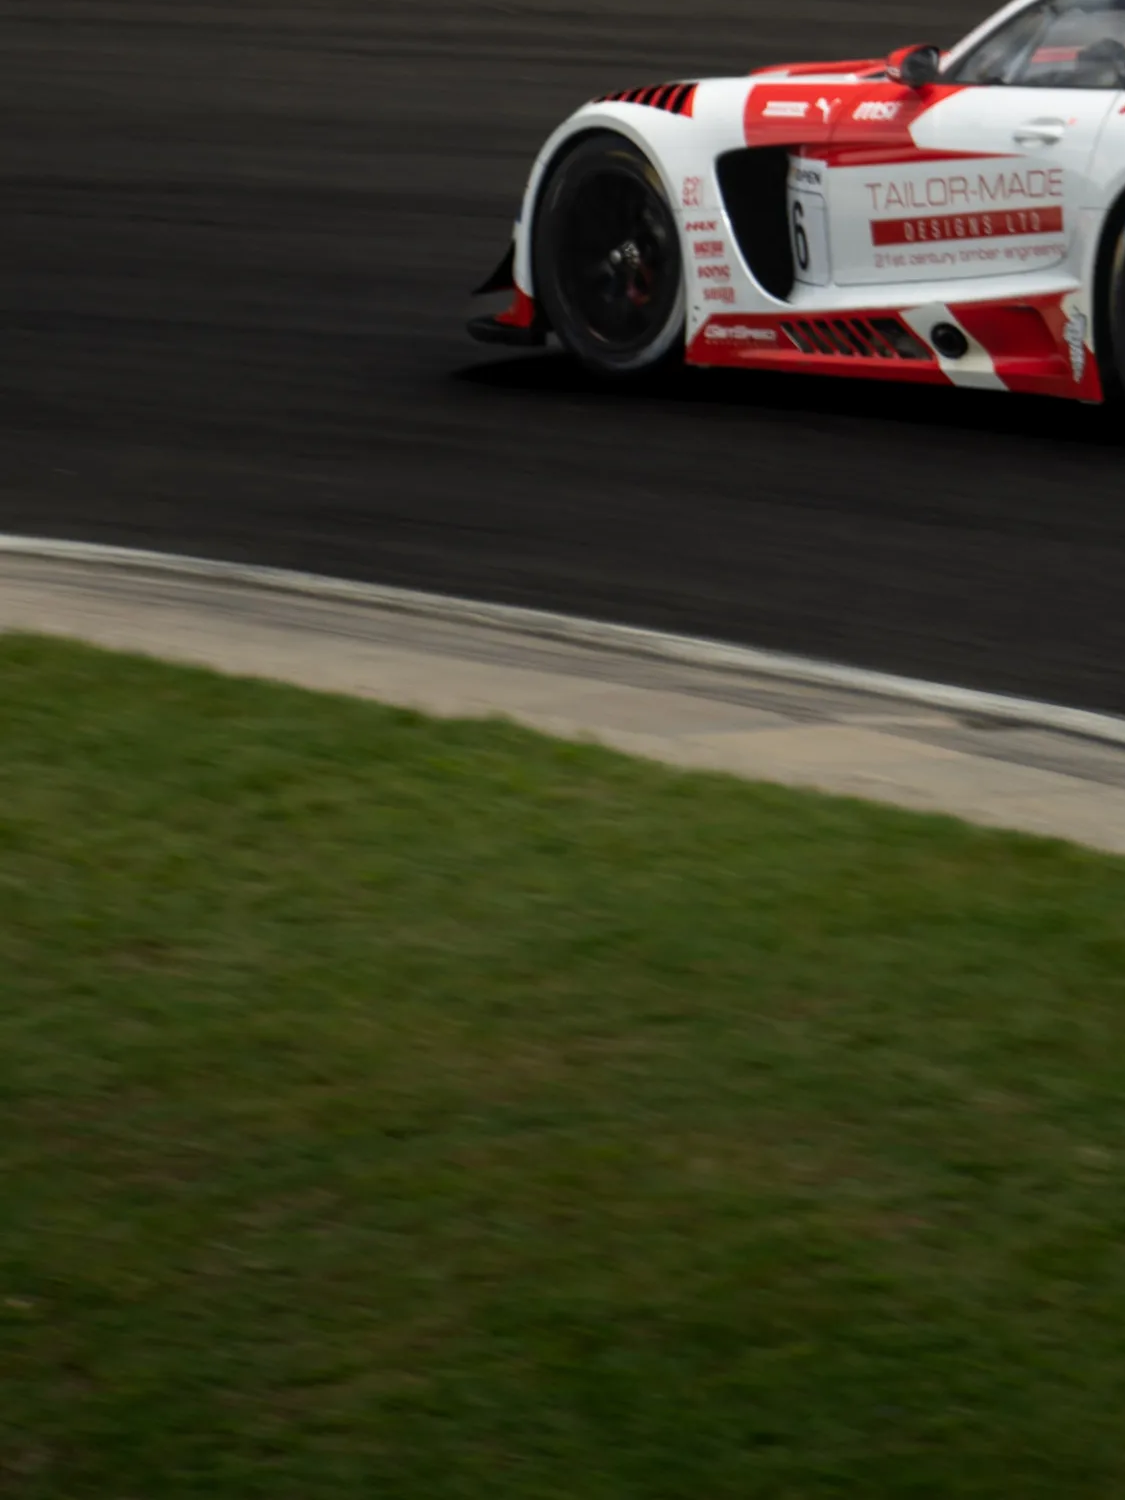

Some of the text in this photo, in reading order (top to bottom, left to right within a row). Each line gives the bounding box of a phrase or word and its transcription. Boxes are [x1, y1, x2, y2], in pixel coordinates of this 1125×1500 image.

[865, 168, 1064, 211] TAILOR-MADE
[793, 201, 809, 271] 6
[904, 210, 1041, 242] DESIGNS LTD
[874, 253, 906, 268] 21st
[908, 250, 956, 266] century
[959, 246, 1001, 263] timber
